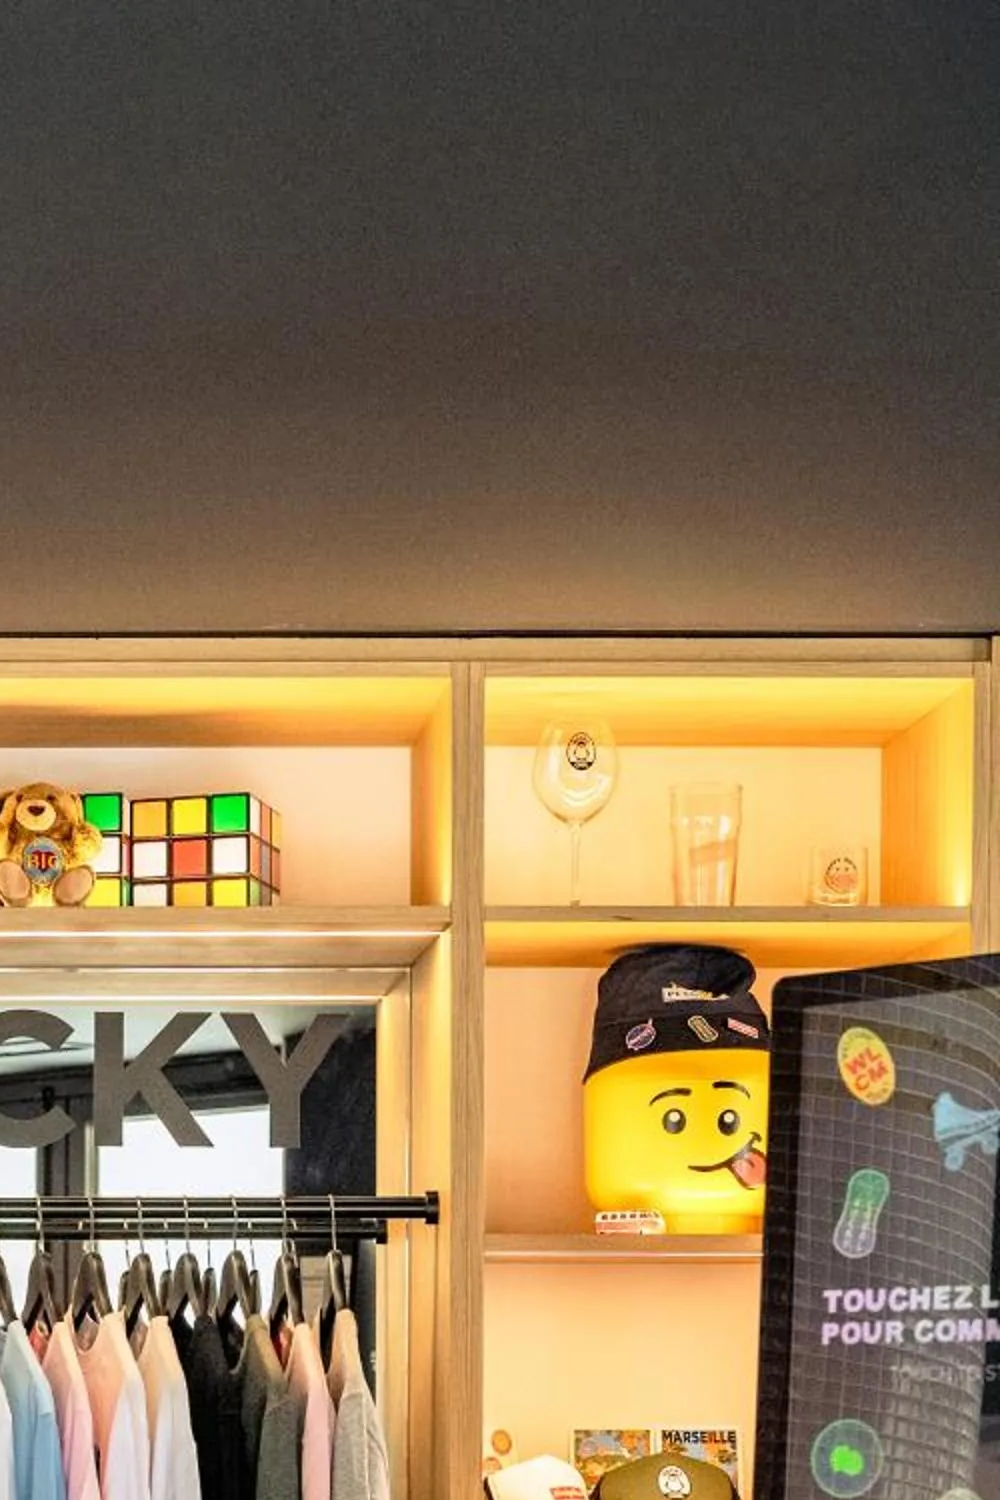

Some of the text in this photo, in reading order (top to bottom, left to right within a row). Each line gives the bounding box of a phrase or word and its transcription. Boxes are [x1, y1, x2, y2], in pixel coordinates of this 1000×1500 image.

[822, 1284, 973, 1314] TOUCHEZ
[821, 1320, 905, 1345] POUR
[661, 1430, 736, 1444] MARSEILLE
